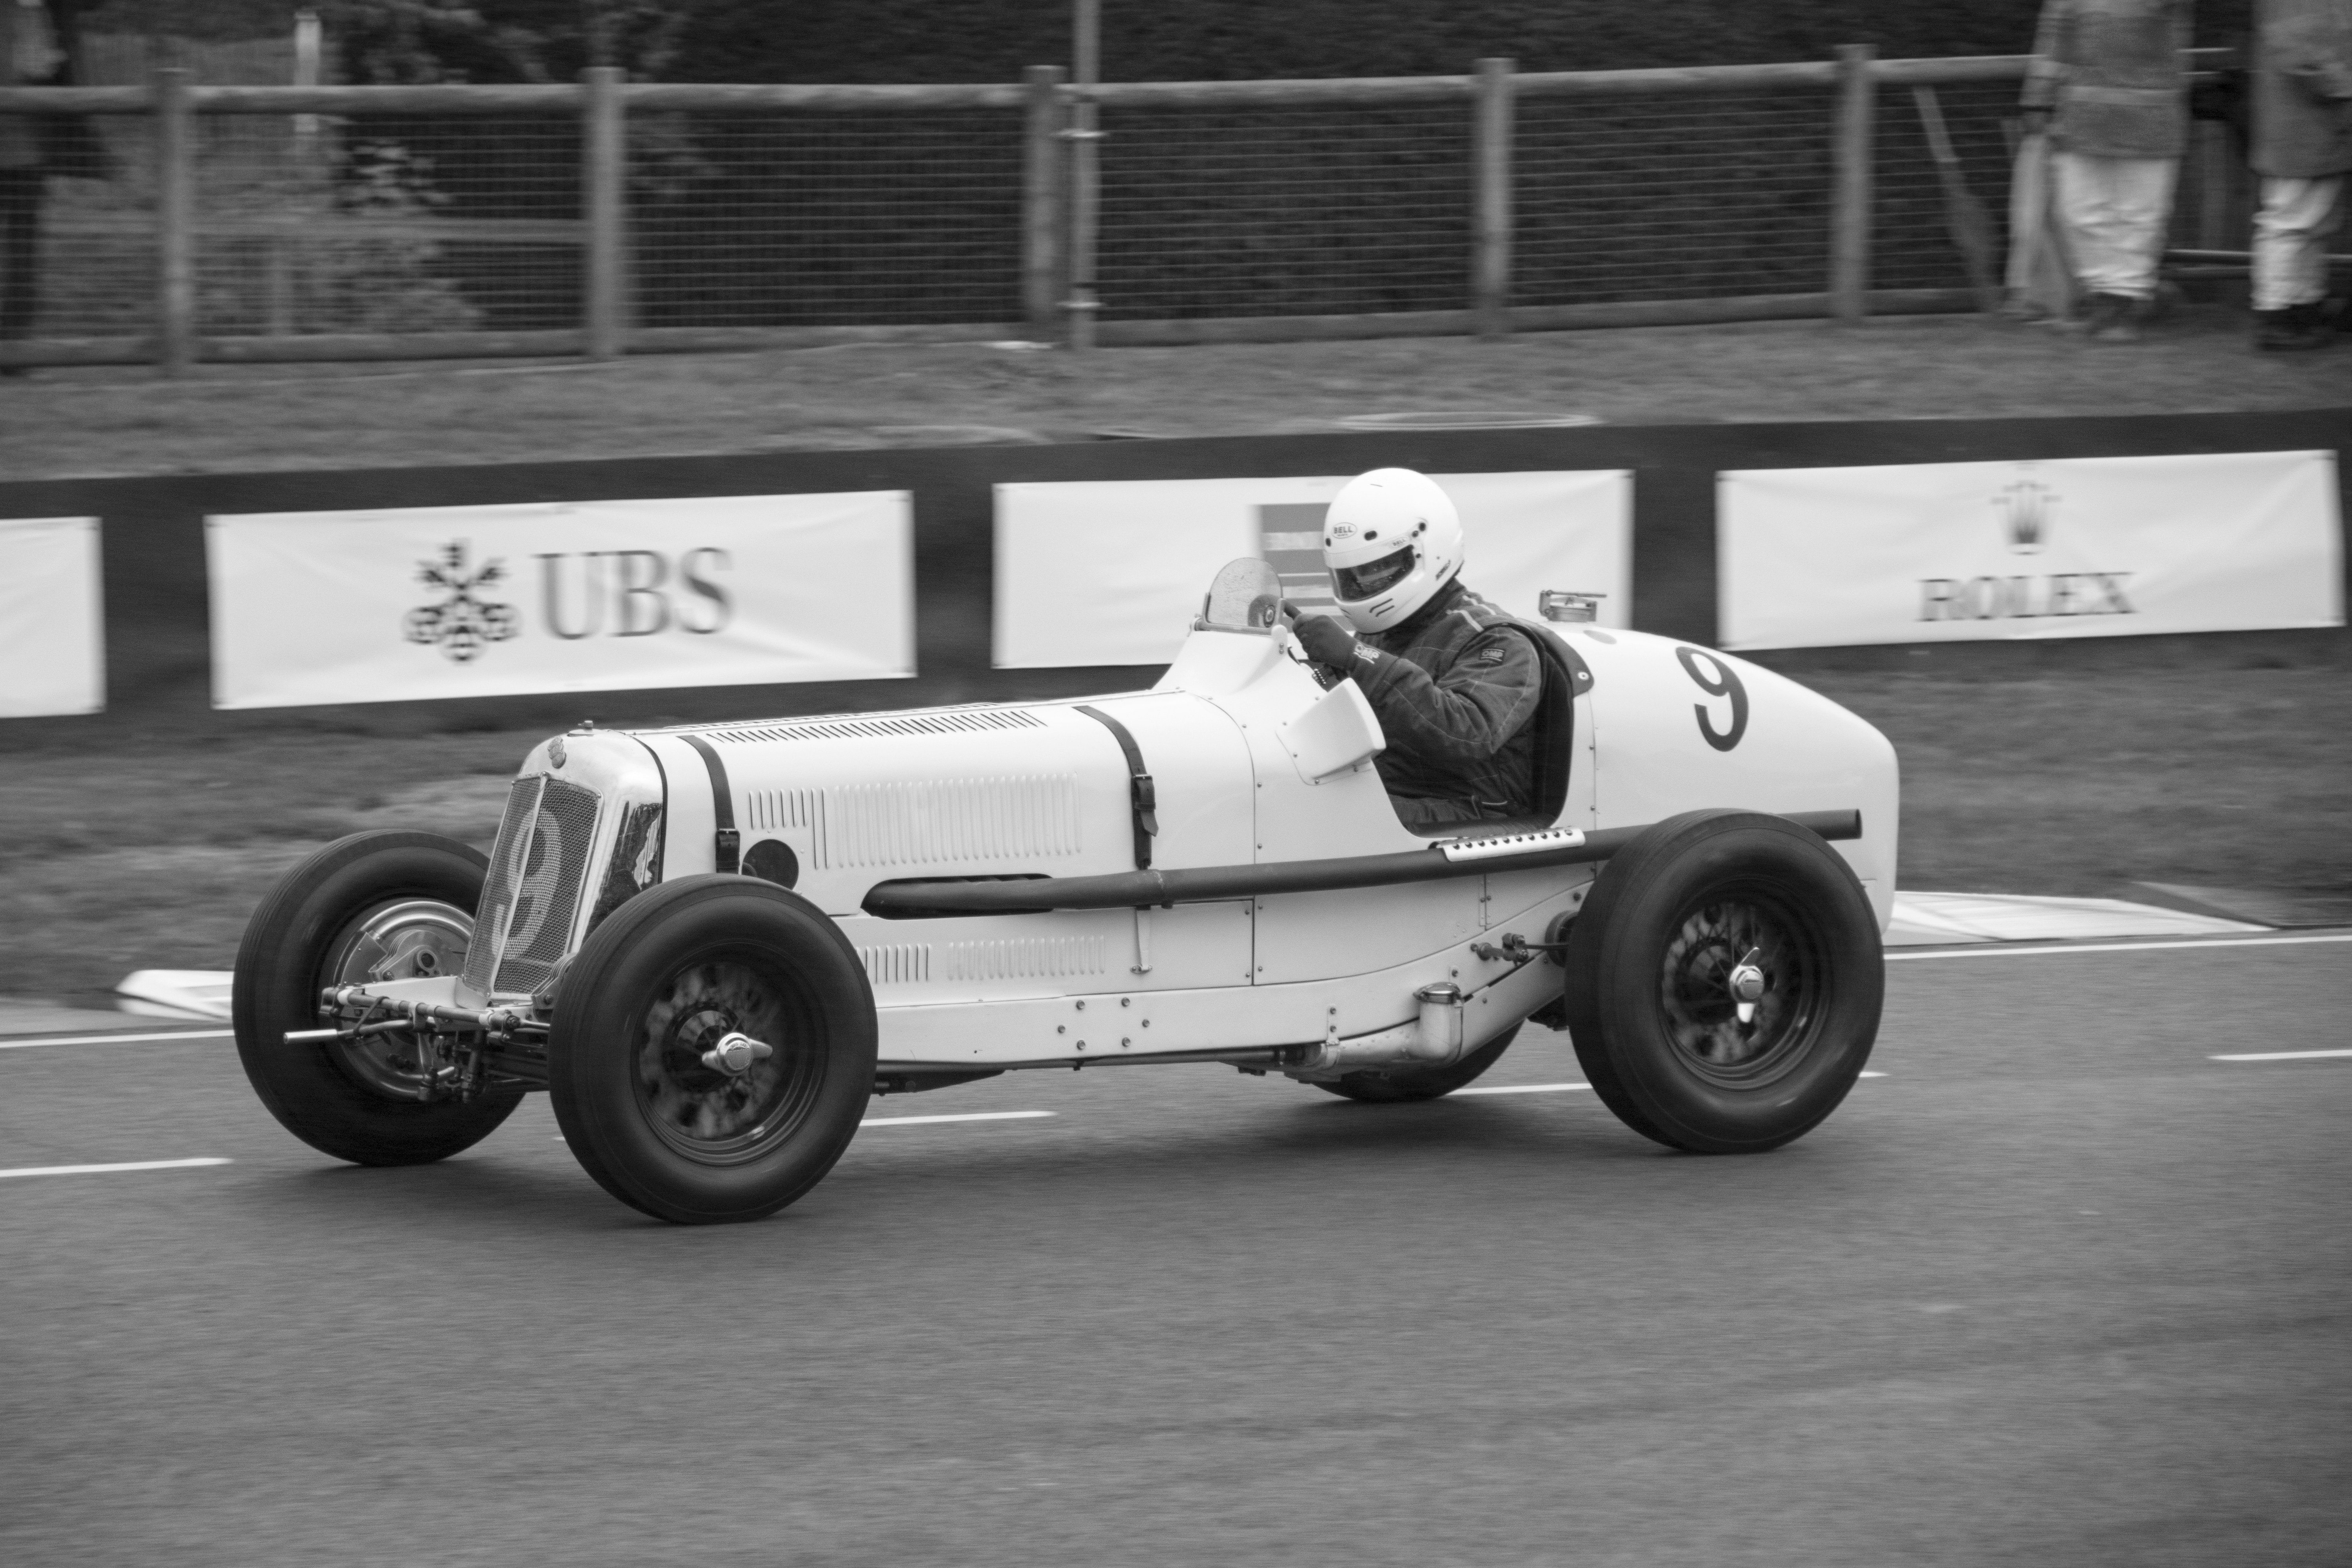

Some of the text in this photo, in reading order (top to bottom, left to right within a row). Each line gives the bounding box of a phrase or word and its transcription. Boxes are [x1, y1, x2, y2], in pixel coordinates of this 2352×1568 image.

[532, 547, 734, 641] UBS
[1918, 571, 2137, 622] ROLEX
[1355, 644, 1379, 659] OMP
[1675, 646, 1749, 752] 9
[492, 805, 563, 961] 9
